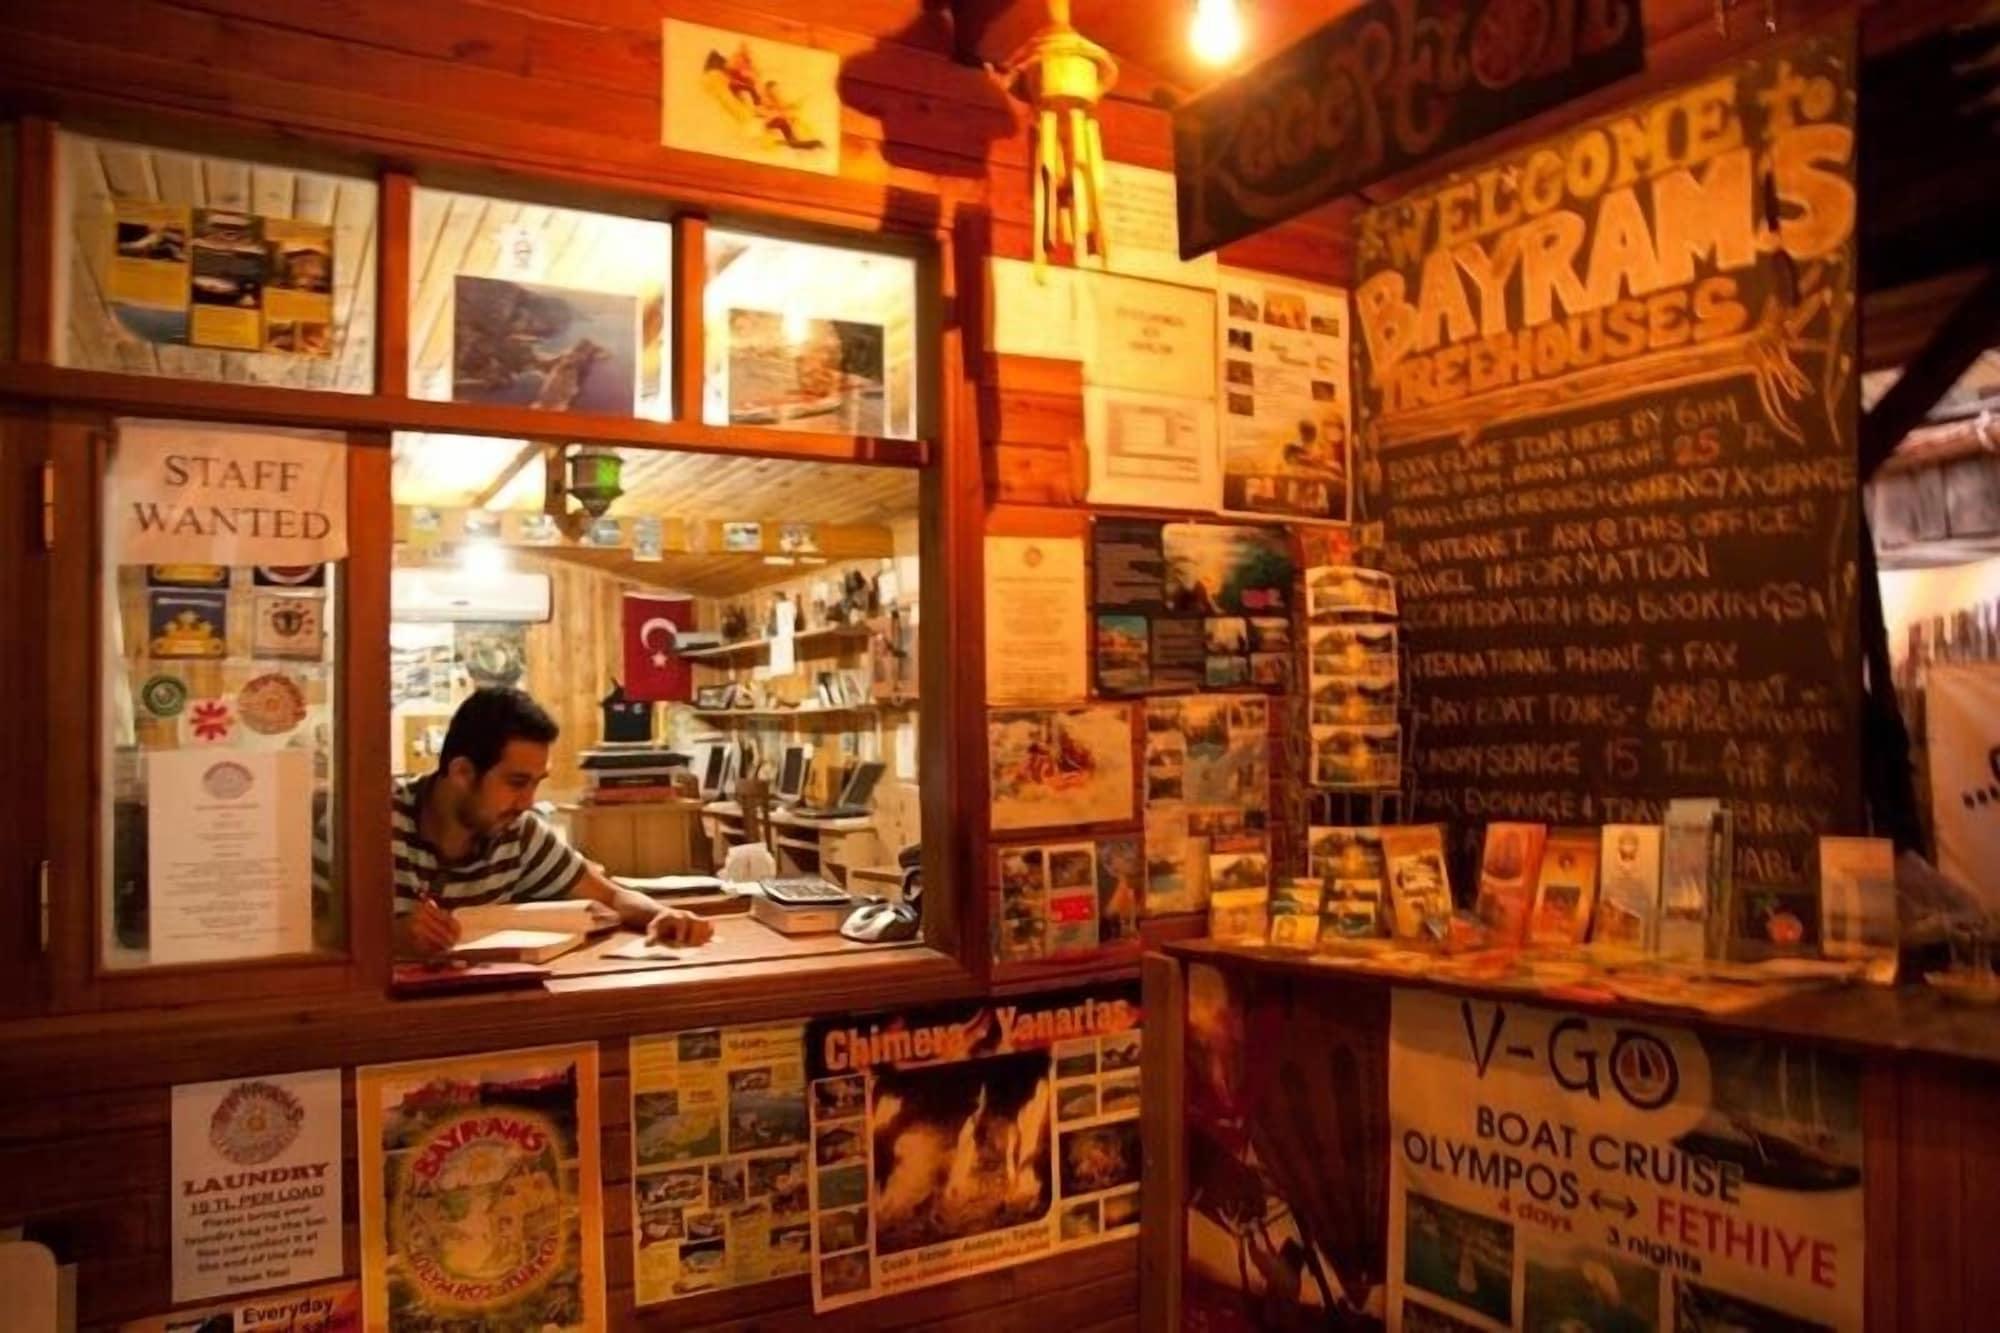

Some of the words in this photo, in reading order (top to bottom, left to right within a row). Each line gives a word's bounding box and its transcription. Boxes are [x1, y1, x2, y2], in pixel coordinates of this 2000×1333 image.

[1362, 76, 1743, 262] WELCOME
[1374, 277, 1750, 413] TREEHOUSES
[1631, 405, 1662, 438] BY
[164, 454, 304, 492] STAFF
[134, 502, 331, 540] WANTED
[1626, 511, 1688, 542] THIS
[1484, 540, 1711, 589] INFORMATION
[1563, 641, 1649, 673] PHONE
[1682, 638, 1739, 671] FAX
[1485, 739, 1581, 778] SERVICE
[1603, 736, 1641, 779] 15
[824, 1020, 966, 1071] Chimera
[1476, 1105, 1578, 1159] BOAT
[1588, 1134, 1745, 1203] CRUISE
[182, 1162, 330, 1197] LAUNDRY
[277, 1184, 324, 1202] LOAD
[1402, 1129, 1581, 1211] OLYMPOS
[1655, 1197, 1840, 1289] FETHIYE
[1517, 1202, 1574, 1232] days
[1607, 1225, 1620, 1246] 3
[1627, 1236, 1703, 1275] nights
[243, 1297, 335, 1325] Everyday
